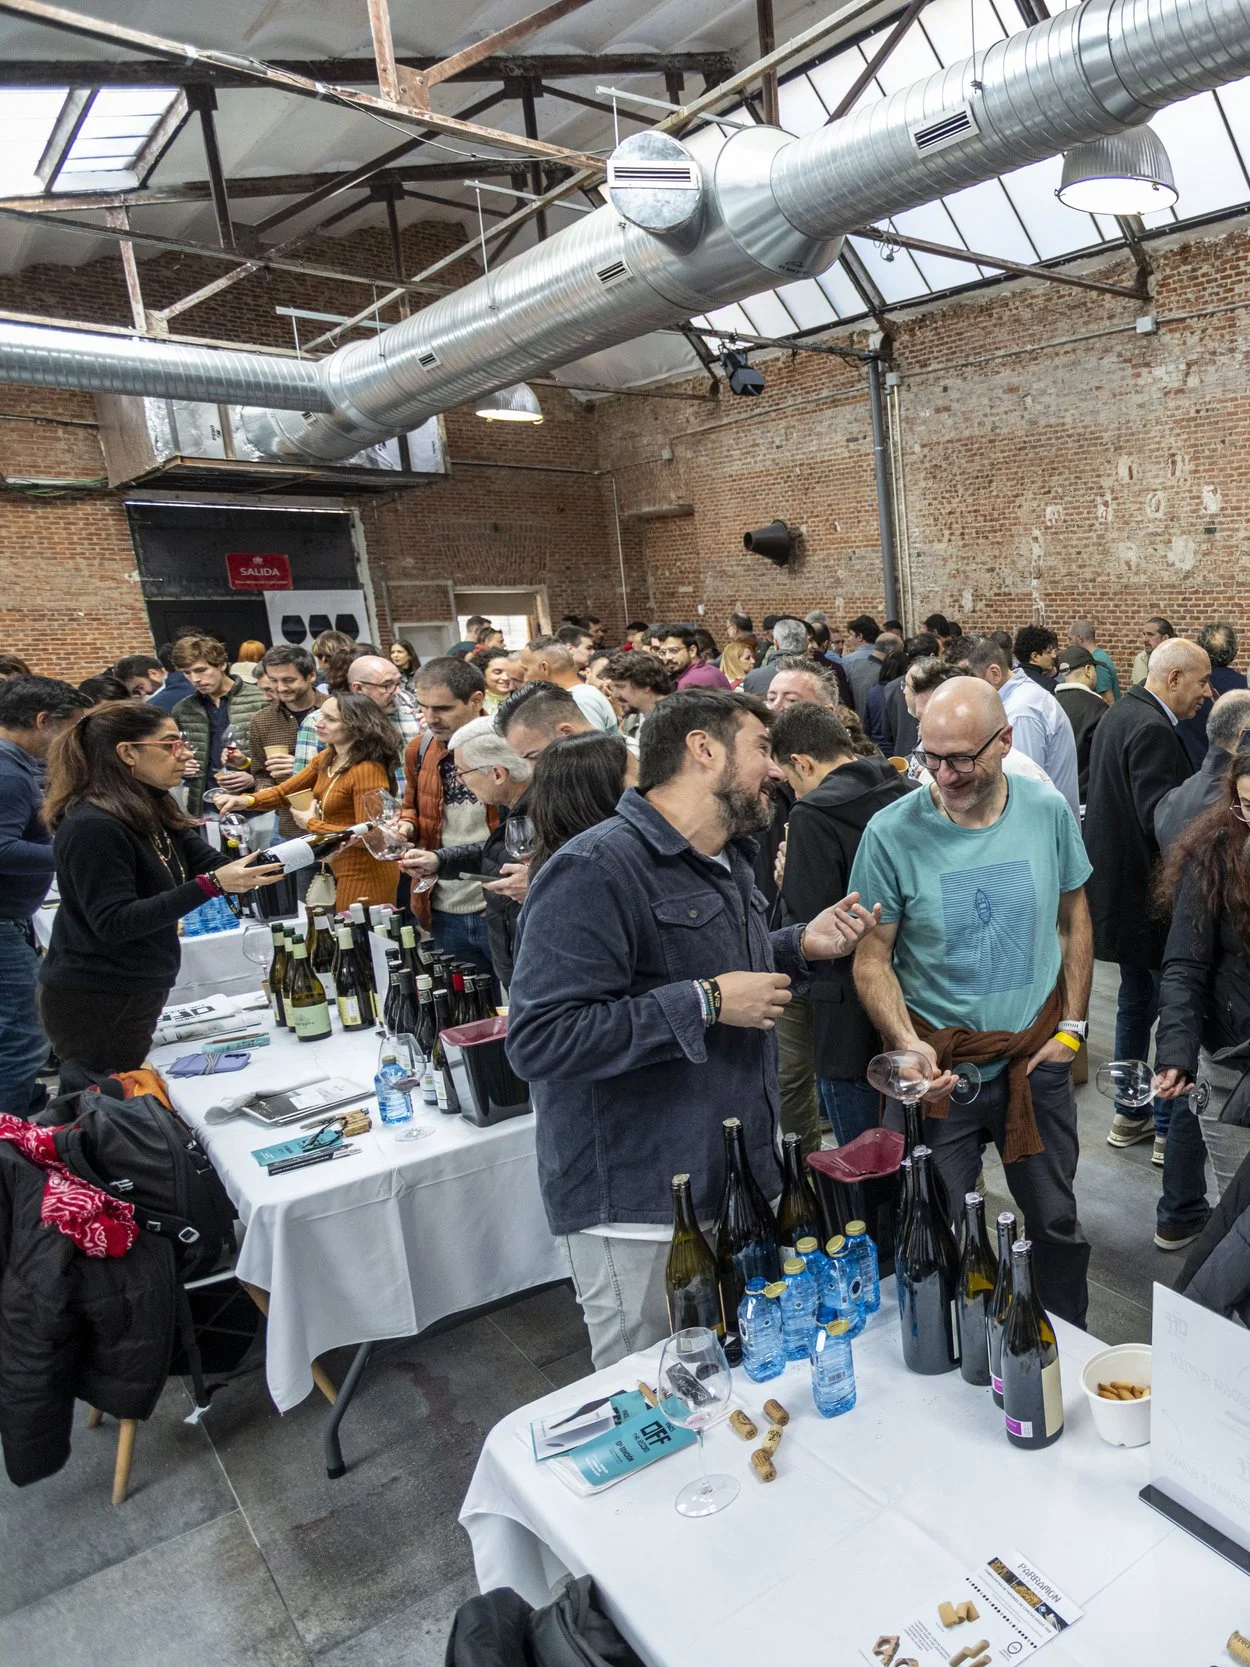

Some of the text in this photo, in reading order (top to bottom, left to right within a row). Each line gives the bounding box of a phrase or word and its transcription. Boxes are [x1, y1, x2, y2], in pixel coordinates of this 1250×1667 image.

[239, 567, 281, 576] SALIDA
[640, 1420, 672, 1447] OFF
[1018, 1563, 1061, 1603] PARRAMON
